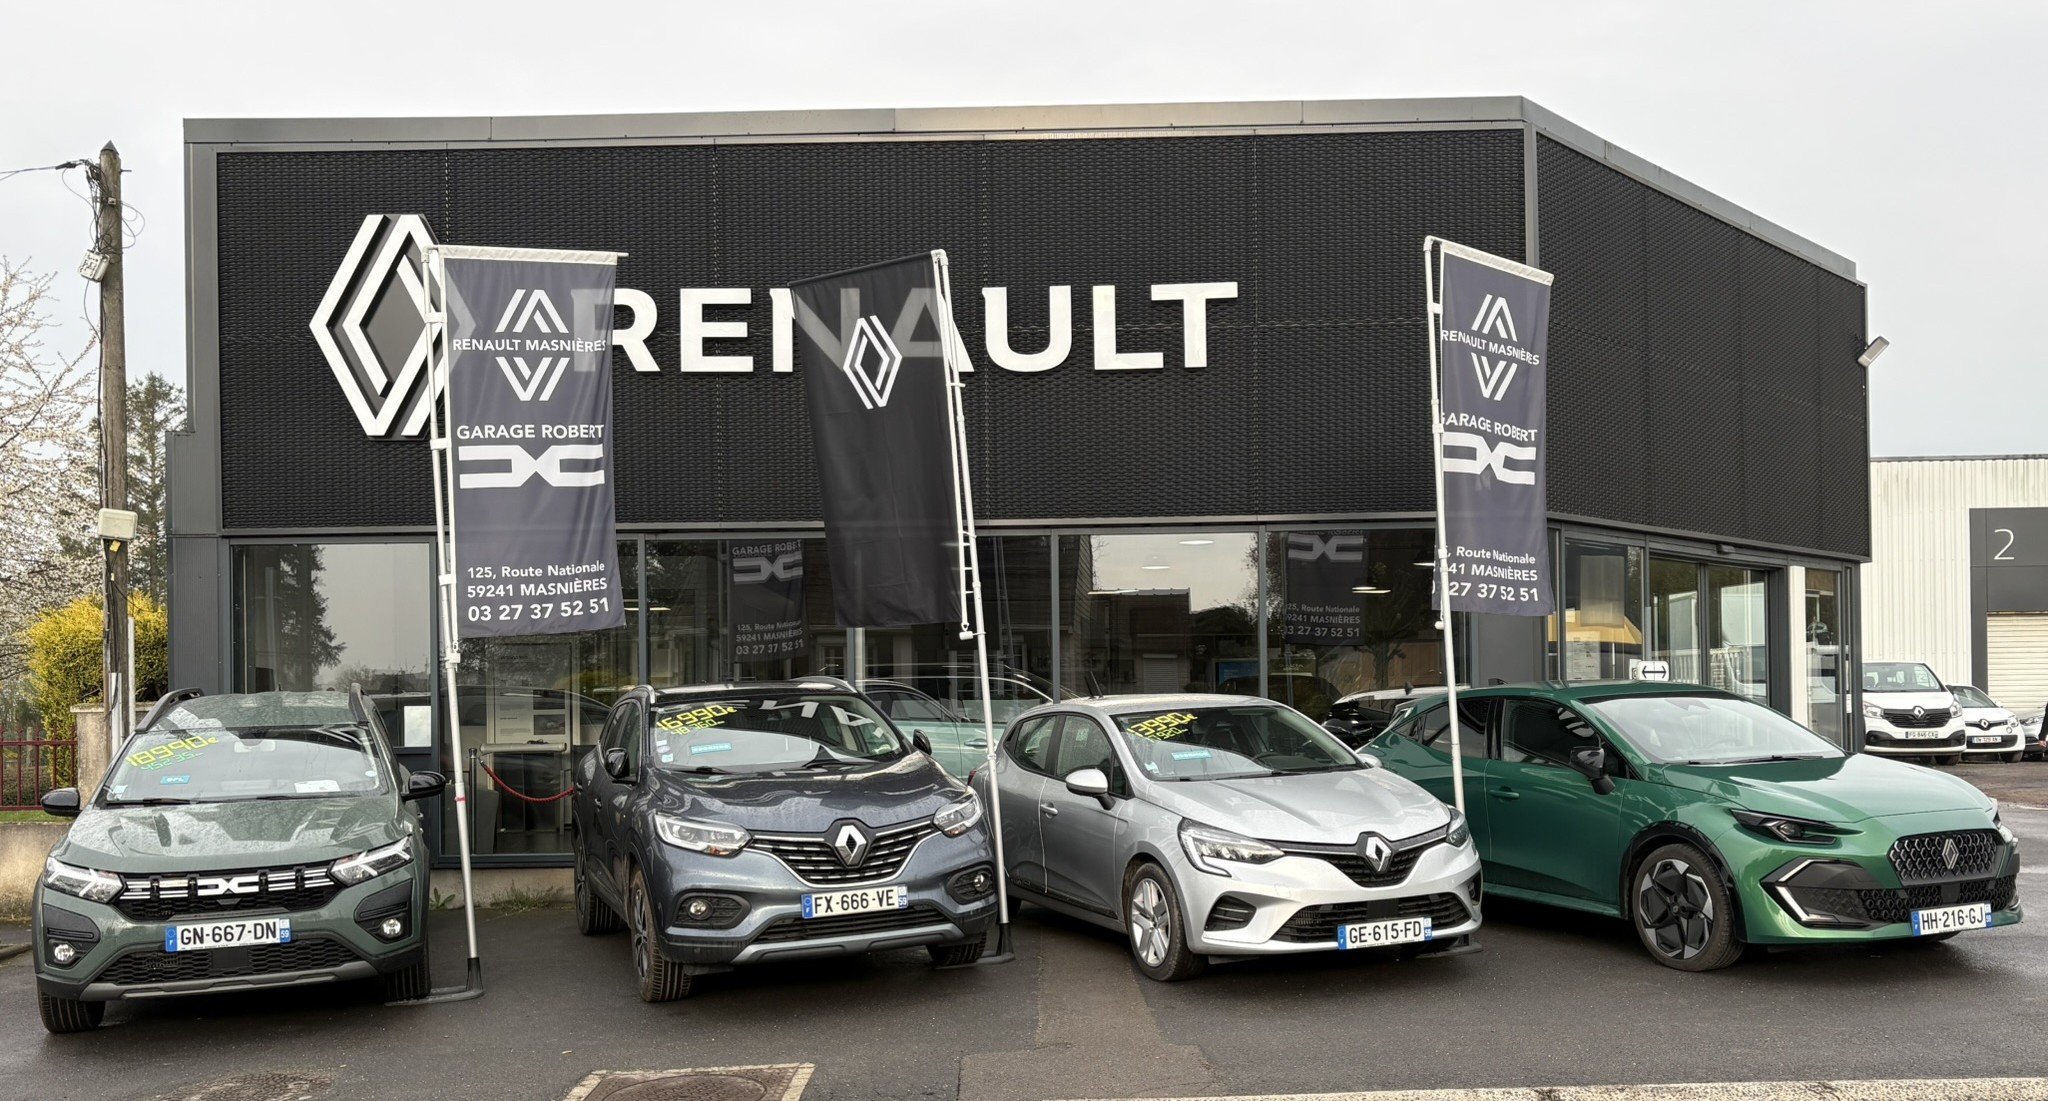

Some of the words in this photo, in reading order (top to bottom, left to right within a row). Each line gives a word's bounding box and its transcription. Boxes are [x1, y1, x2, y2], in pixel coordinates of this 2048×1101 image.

[570, 281, 1239, 373] RENAULT
[453, 339, 521, 351] RENAULT
[1441, 330, 1487, 350] RENAULT
[1489, 342, 1540, 366] MASNIÈRES
[457, 424, 535, 440] GARAGE
[542, 424, 604, 439] ROBERT
[1495, 424, 1538, 442] ROBERT
[732, 544, 773, 555] GARAGE
[1993, 528, 2015, 560] 2
[1456, 546, 1491, 559] Route
[1493, 549, 1536, 564] Nationale
[467, 568, 497, 579] 125,
[501, 566, 543, 578] Route
[547, 560, 605, 577] Nationale
[1471, 564, 1538, 581] MASNIÈRES
[467, 584, 514, 598] 59241
[520, 577, 607, 597] MASNIÈRES
[1448, 581, 1471, 597] 27
[1477, 583, 1498, 599] 37
[1500, 586, 1515, 601] 52
[1519, 588, 1539, 602] 51
[468, 605, 492, 622] 03
[498, 604, 523, 621] 27
[530, 603, 553, 619] 37
[560, 601, 583, 617] 52
[589, 597, 609, 614] 51
[814, 889, 895, 914] FX-666-VE
[1921, 907, 1984, 931] HH-216-GJ
[180, 921, 277, 945] GN-667-DN
[281, 929, 290, 939] 59
[1349, 921, 1422, 944] GE-615-FD
